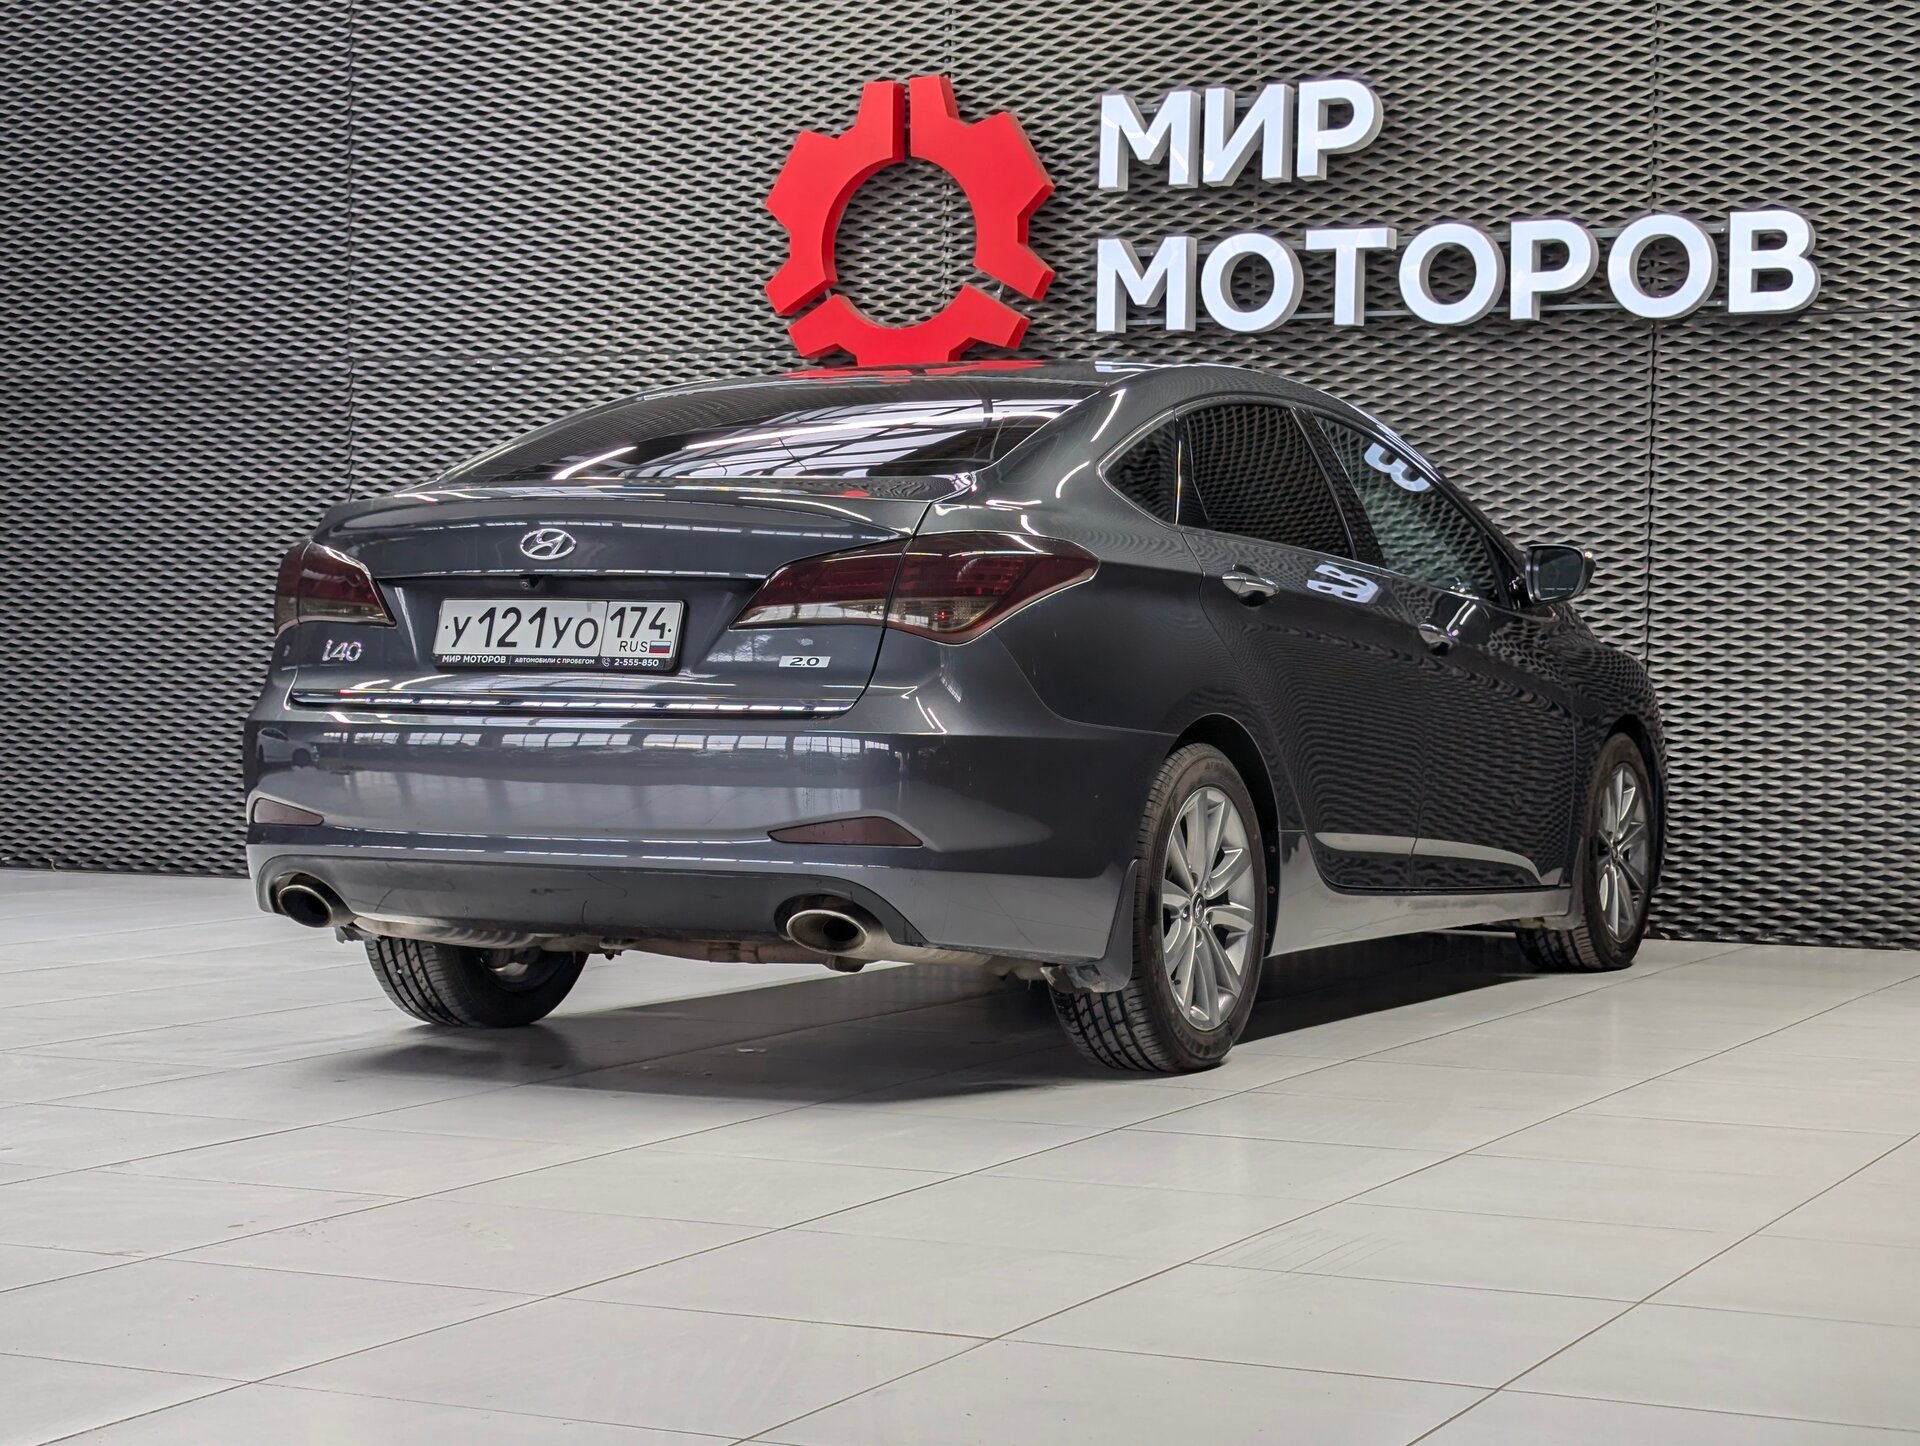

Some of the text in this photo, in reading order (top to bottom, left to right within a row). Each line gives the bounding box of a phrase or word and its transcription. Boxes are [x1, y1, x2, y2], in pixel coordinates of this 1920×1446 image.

[1098, 78, 1384, 191] МИР
[1096, 210, 1821, 334] МОТОРОВ
[451, 606, 666, 649] У121УО 174
[322, 640, 362, 662] i40
[618, 640, 648, 653] RUS
[442, 655, 461, 663] МИР
[462, 655, 507, 664] МОТОРОВ
[514, 657, 556, 665] АВТОМОБИЛИ
[614, 658, 660, 667] 2-555-850
[789, 656, 820, 667] 2.0
